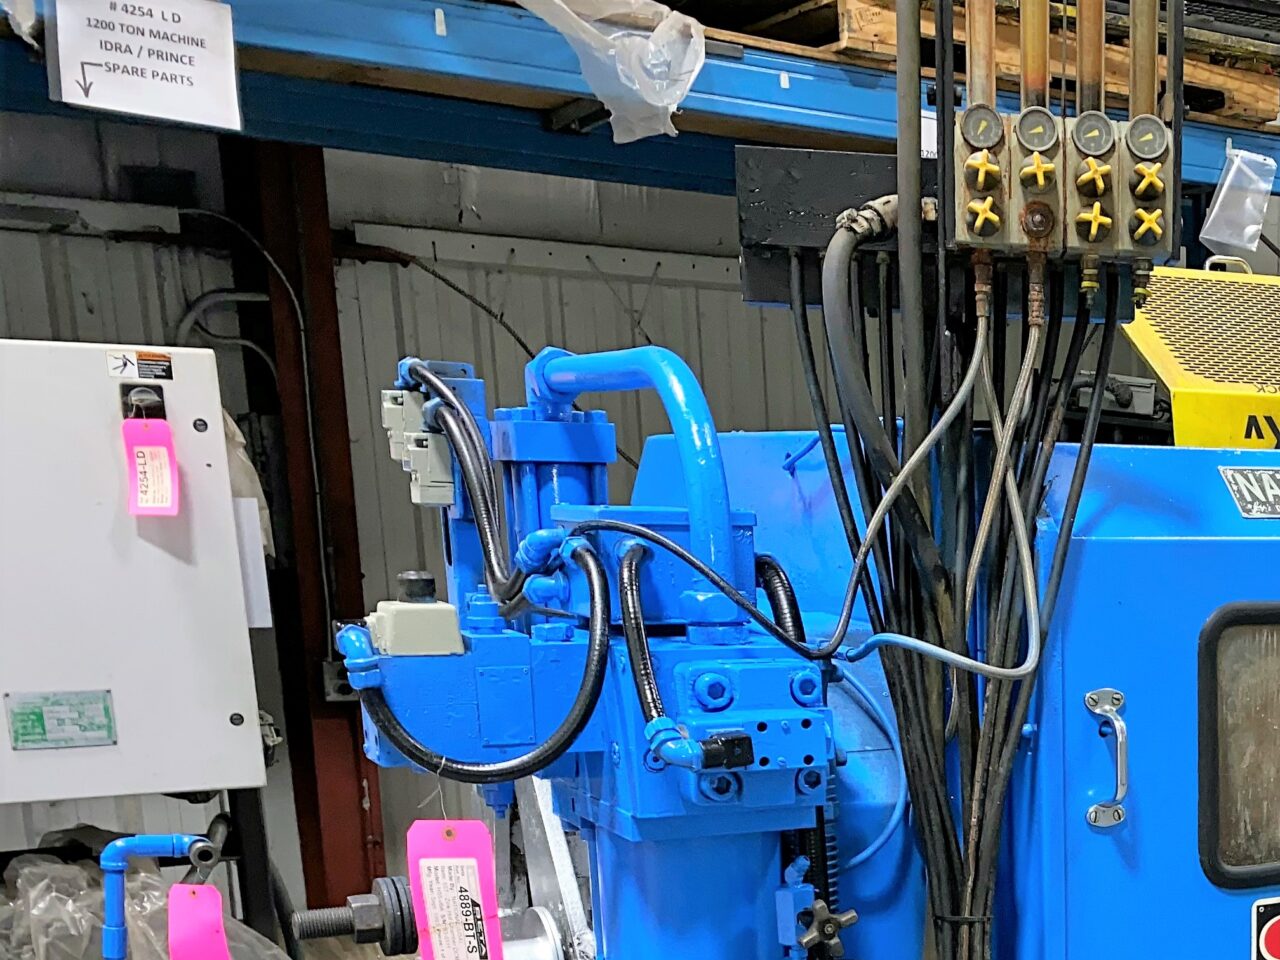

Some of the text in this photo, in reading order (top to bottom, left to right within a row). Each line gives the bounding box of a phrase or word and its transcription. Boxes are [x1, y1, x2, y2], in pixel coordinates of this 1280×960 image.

[109, 1, 117, 11] #
[121, 3, 154, 19] 4254
[86, 17, 207, 49] 1200 TON MACHINE
[99, 40, 133, 55] IDRA
[147, 48, 195, 67] PRINCE
[104, 62, 194, 87] SPARE PARTS
[136, 450, 149, 496] 4254-LD
[459, 886, 477, 954] 4889-BT-S
